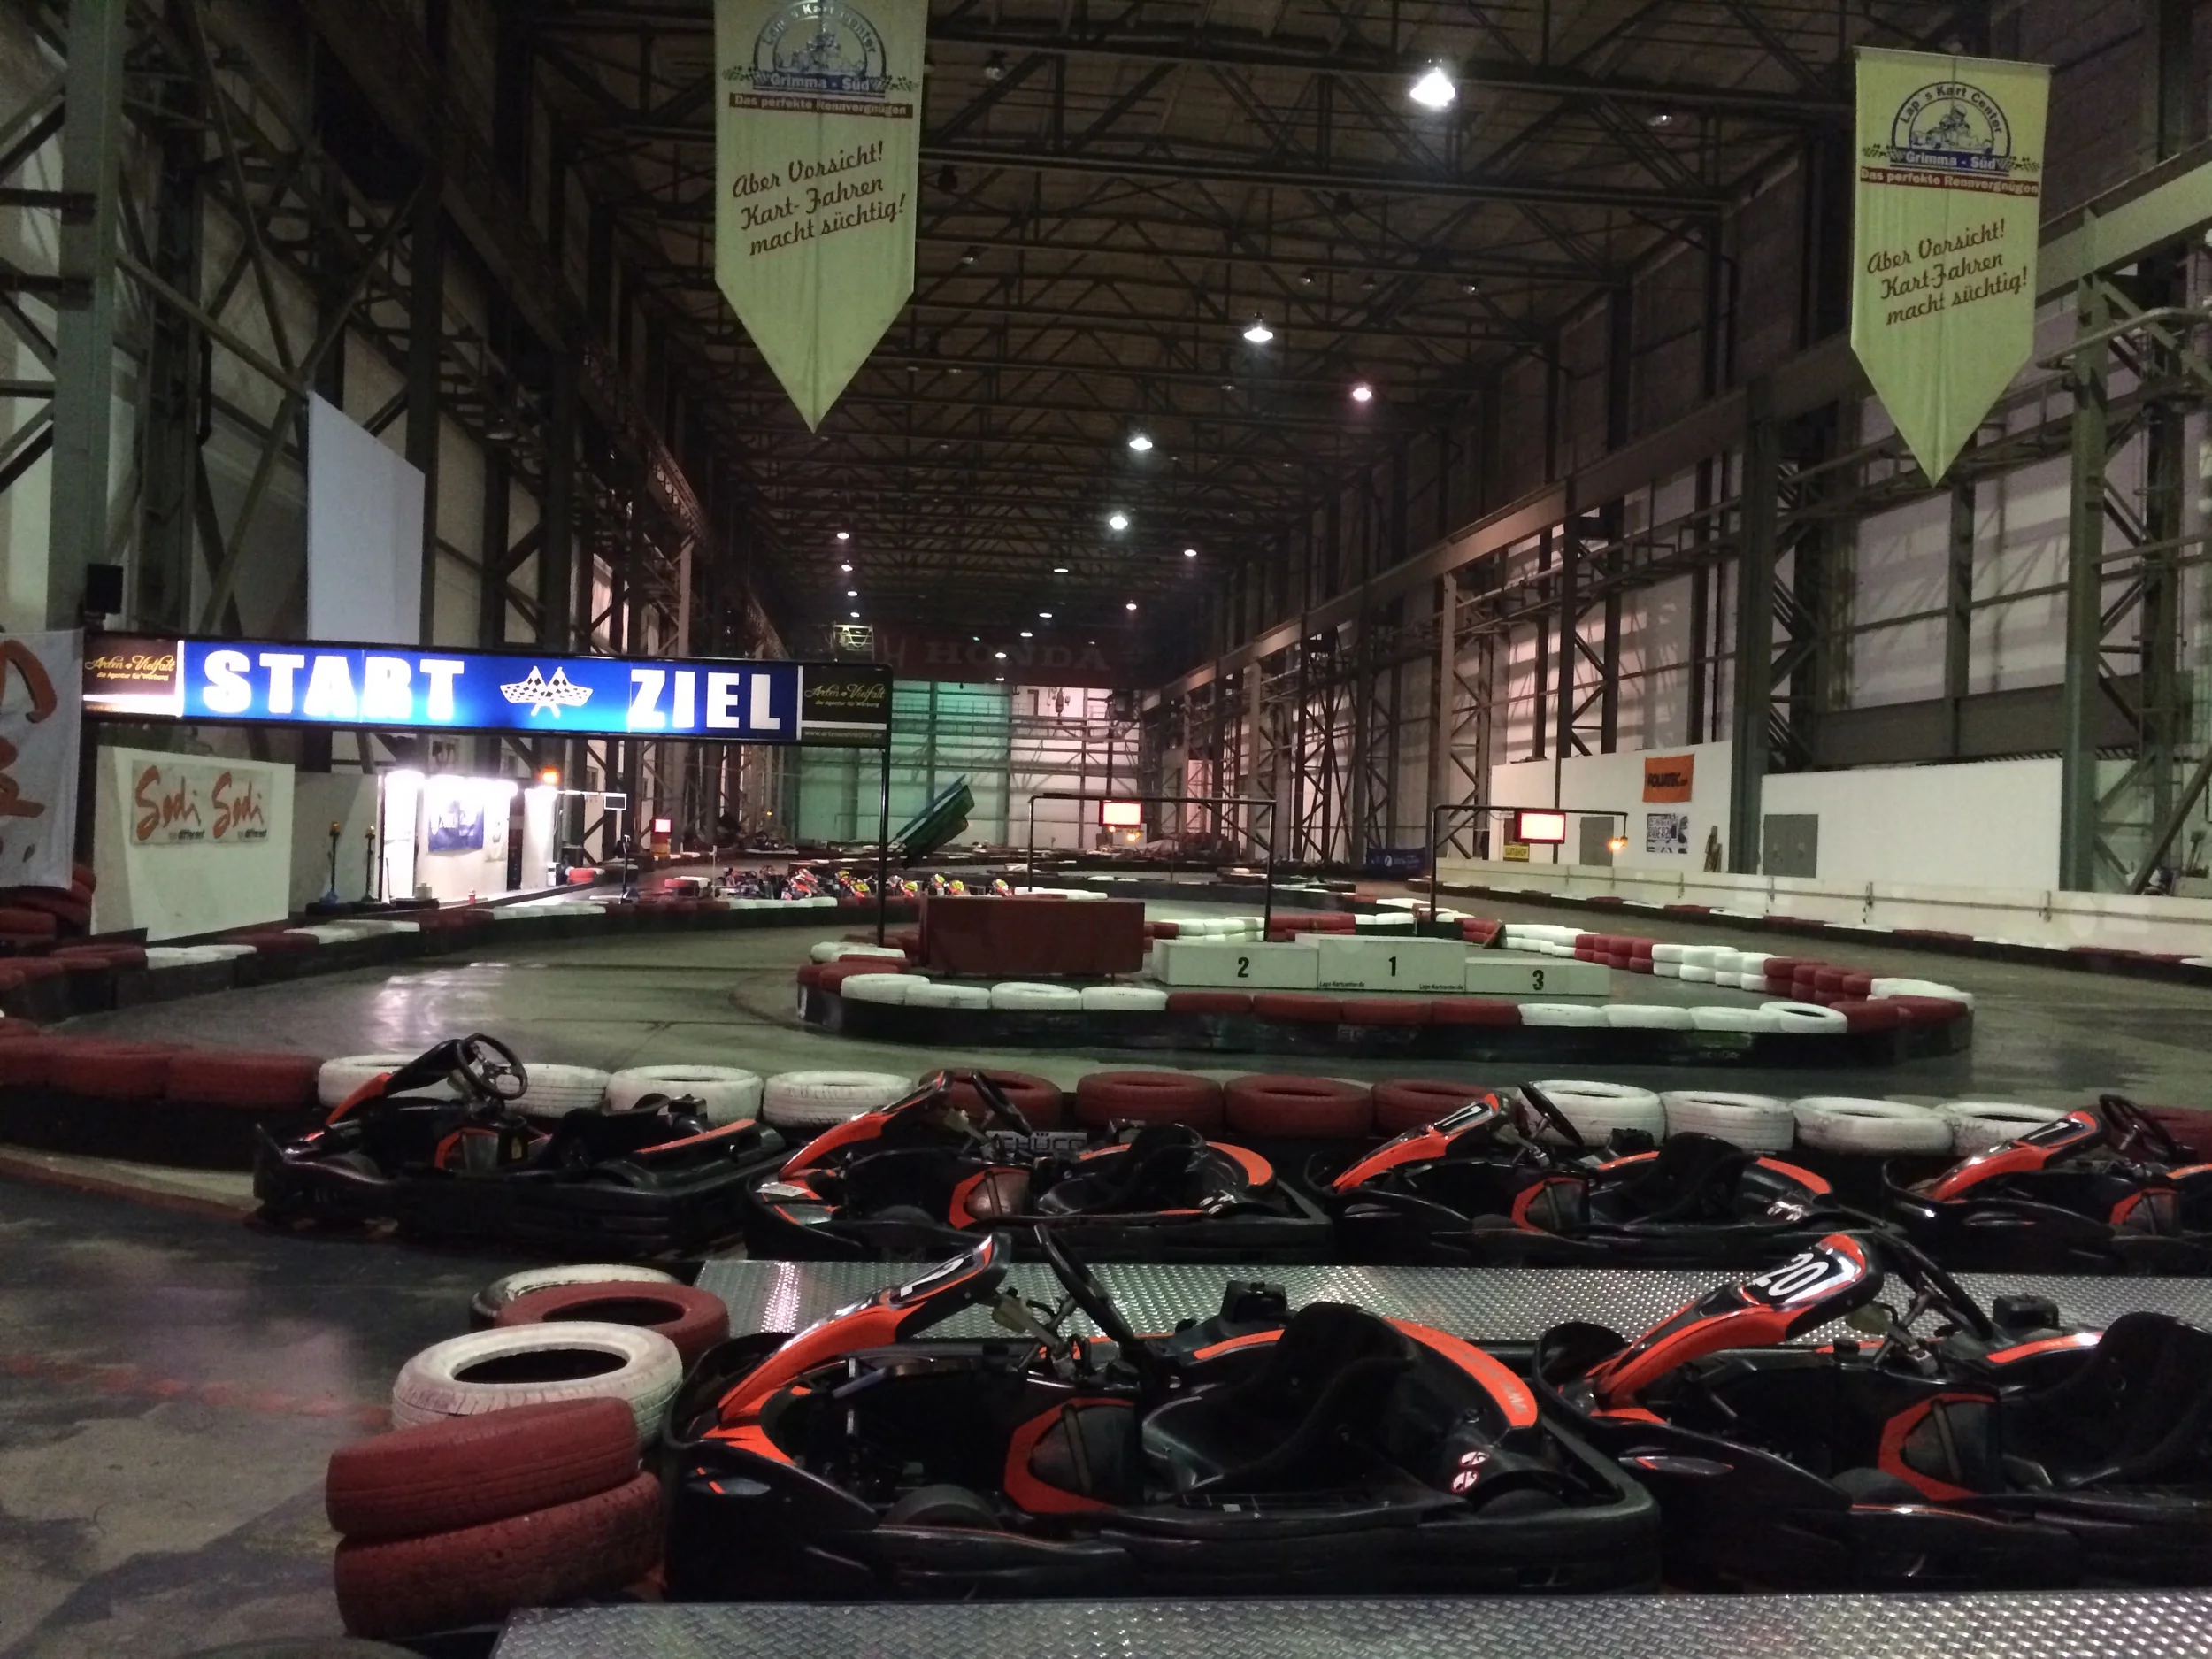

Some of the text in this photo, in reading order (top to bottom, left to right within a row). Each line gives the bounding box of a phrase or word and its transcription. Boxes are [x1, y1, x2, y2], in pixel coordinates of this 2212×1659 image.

[734, 95, 758, 106] Das
[770, 73, 827, 89] Grimma
[842, 76, 871, 91] Süd
[1936, 86, 1967, 97] Kart
[1970, 91, 2002, 134] Center
[733, 140, 884, 198] Aber Vorsicht!
[1861, 167, 1884, 180] Das
[1886, 171, 1941, 186] perfekte
[1905, 150, 1958, 166] Grimma
[1970, 157, 1996, 170] Süd
[749, 192, 906, 257] macht süchtig!
[1866, 218, 2005, 274] Aber Vorsicht!
[1886, 265, 2028, 326] macht süchtig!
[925, 641, 1112, 671] HONDA
[203, 650, 465, 721] START
[627, 668, 780, 730] ZIEL
[1237, 956, 1249, 978] 2
[1388, 956, 1397, 977] 1
[1532, 969, 1544, 991] 3
[1752, 1252, 1830, 1297] 20
